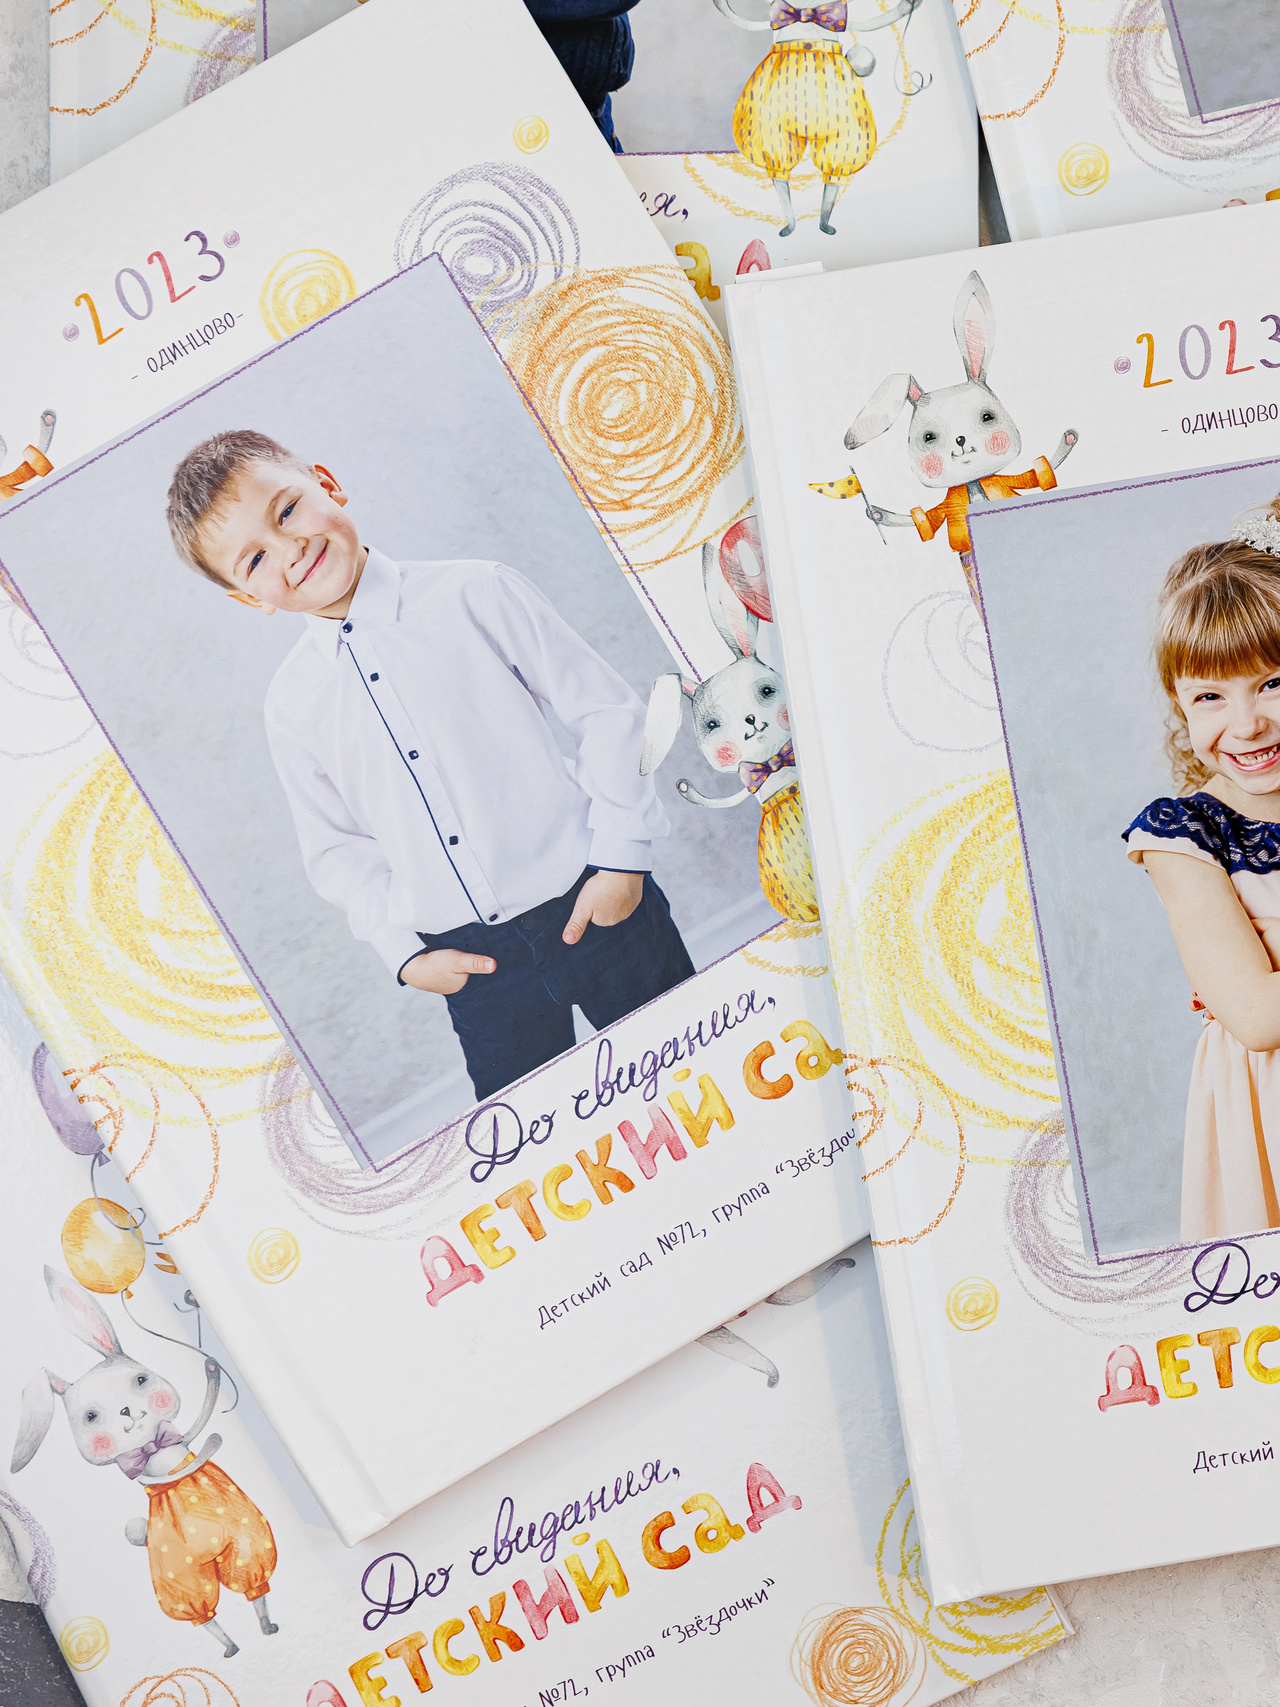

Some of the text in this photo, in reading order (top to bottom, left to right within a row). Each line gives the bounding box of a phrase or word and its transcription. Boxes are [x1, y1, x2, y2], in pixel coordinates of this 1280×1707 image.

[74, 230, 225, 345] 2023
[465, 990, 776, 1183] До свидания,
[420, 1067, 735, 1307] ДЕТСКИЙ
[538, 1271, 611, 1330] Детский
[619, 1250, 653, 1277] сад
[656, 1221, 708, 1256] №72,
[711, 1181, 770, 1223] группа
[1193, 1441, 1274, 1473] Детский
[361, 1459, 680, 1631] До свидания,
[595, 1643, 655, 1683] группа
